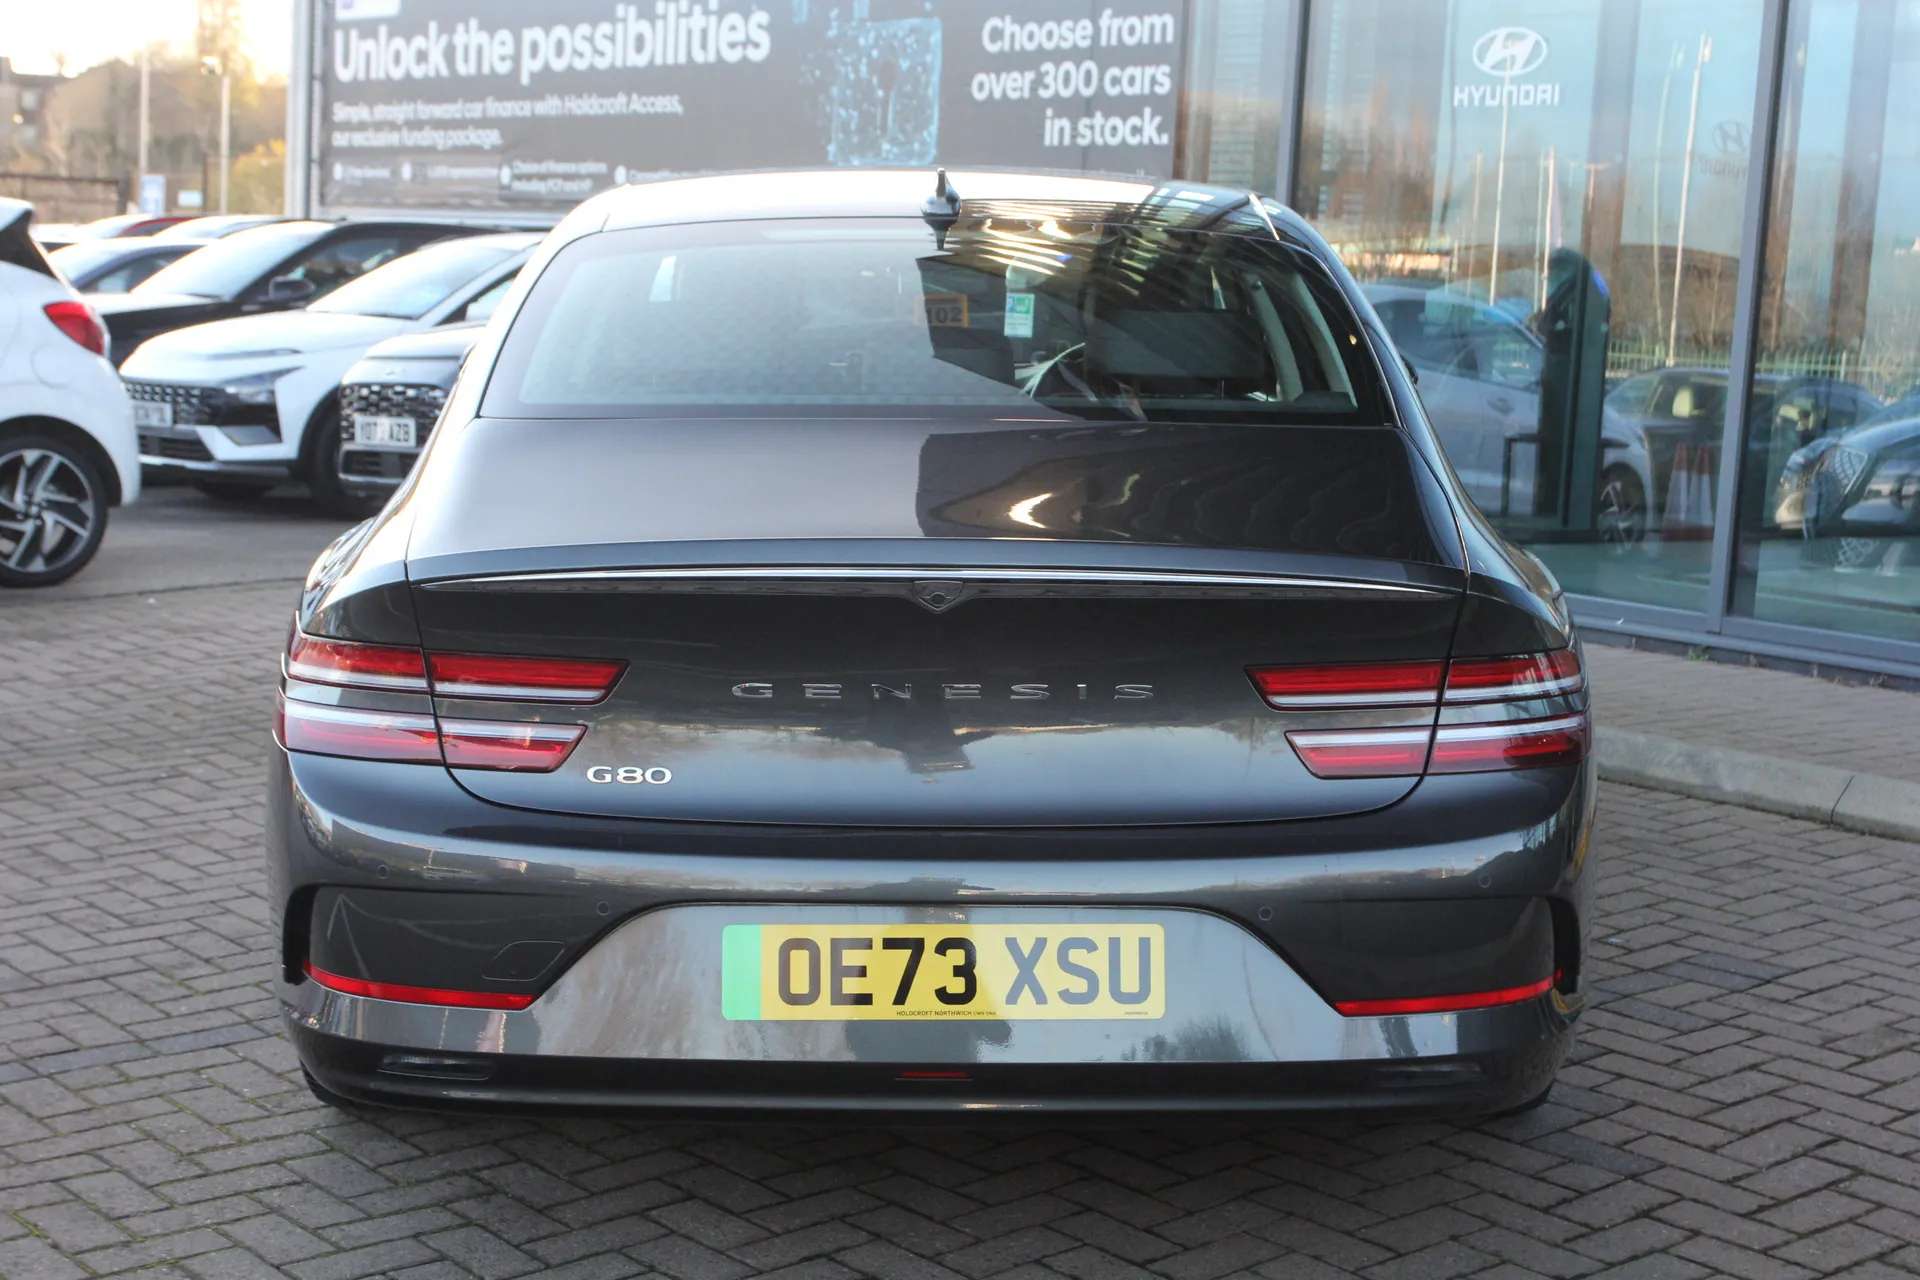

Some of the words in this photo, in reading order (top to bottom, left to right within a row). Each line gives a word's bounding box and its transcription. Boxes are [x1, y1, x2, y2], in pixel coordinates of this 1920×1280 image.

[333, 22, 450, 83] Unlock
[453, 17, 515, 77] the
[521, 0, 772, 86] possibilities
[981, 15, 1093, 53] Choose
[1099, 9, 1175, 47] from
[970, 69, 1037, 101] over
[1038, 60, 1099, 99] 300
[1103, 63, 1172, 97] cars
[1453, 82, 1561, 109] HYUNDAI
[1043, 107, 1072, 147] in
[1077, 105, 1171, 147] stock.
[731, 682, 1154, 700] GENESIS
[586, 766, 673, 785] G80
[777, 937, 978, 1006] OE73
[1004, 936, 1153, 1006] XSU
